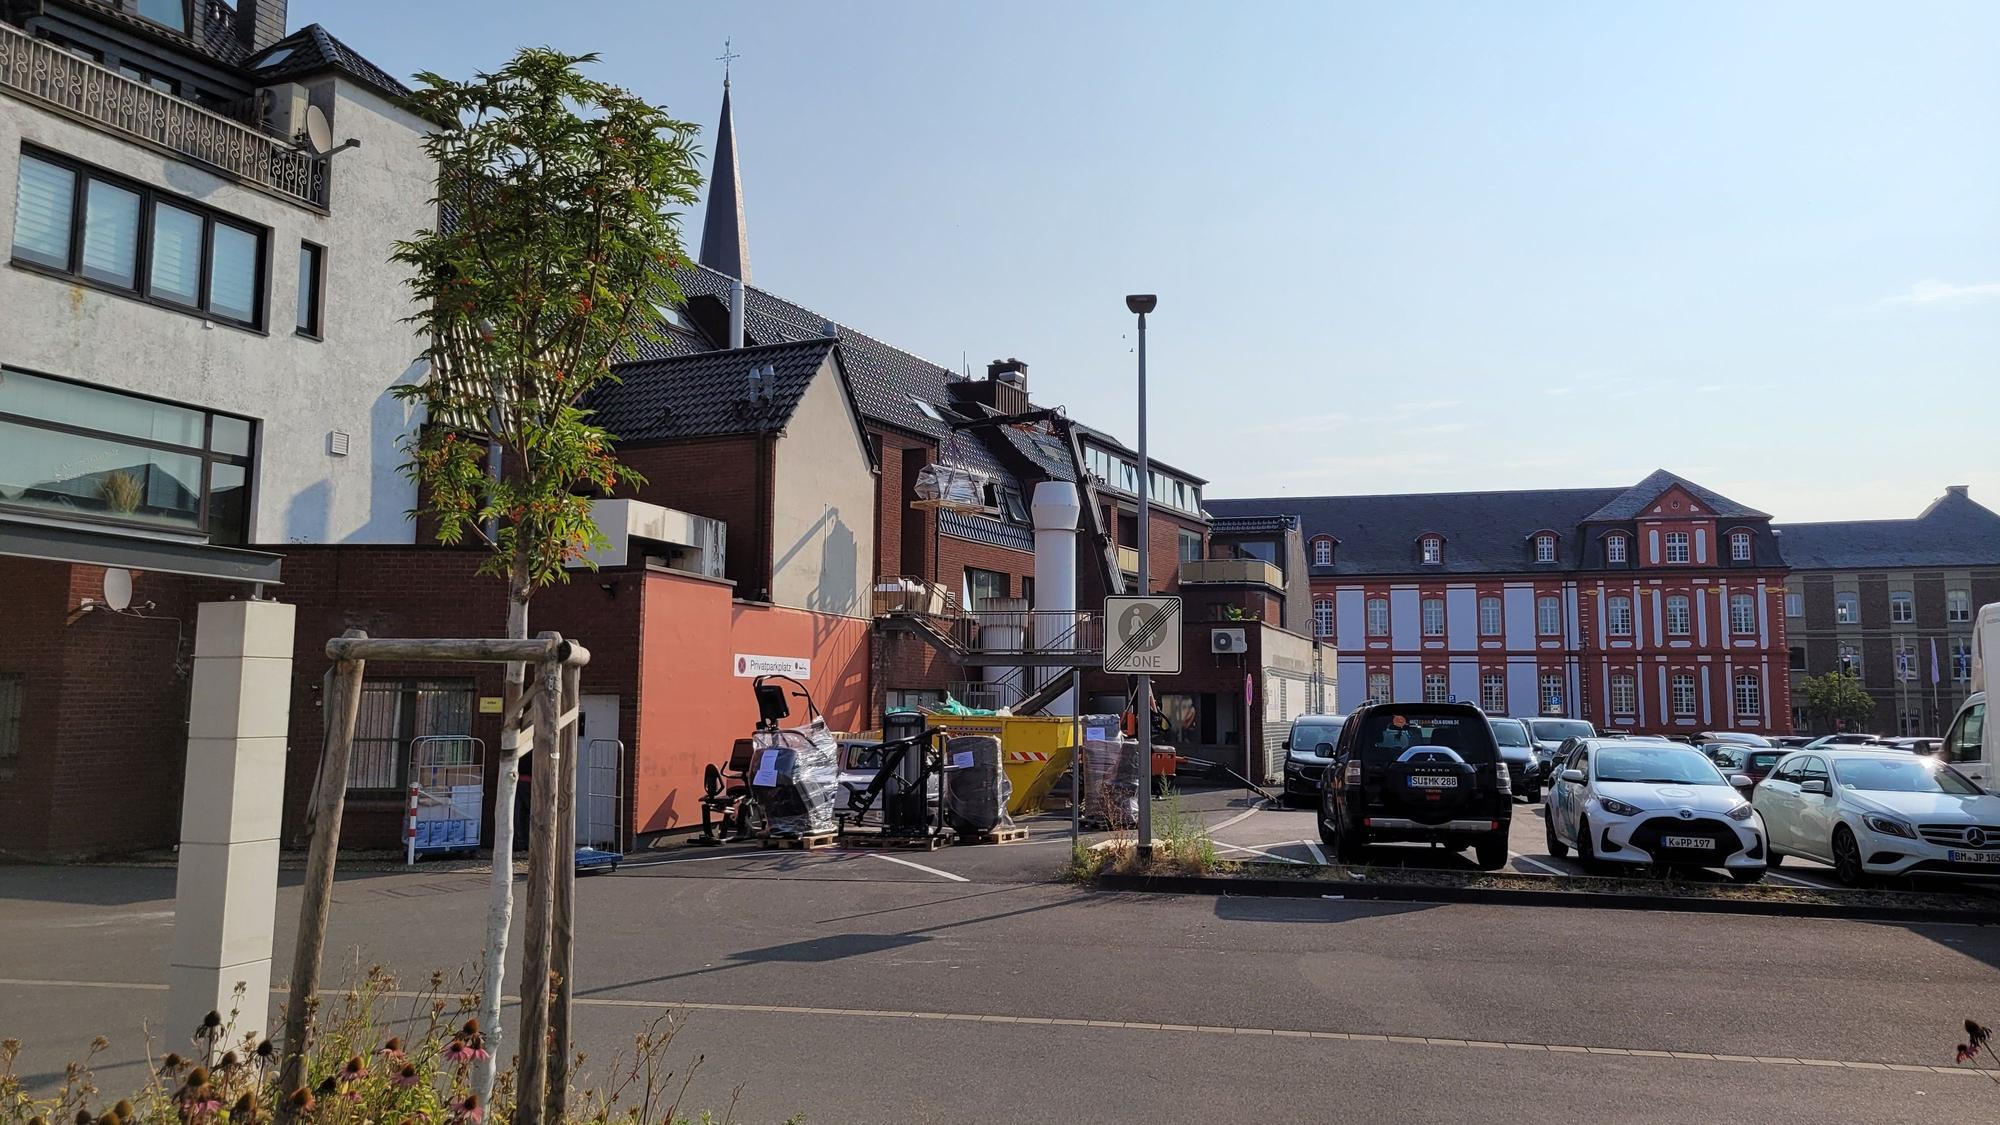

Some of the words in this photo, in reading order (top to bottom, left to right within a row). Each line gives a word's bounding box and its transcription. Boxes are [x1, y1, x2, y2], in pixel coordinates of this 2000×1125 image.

[750, 659, 792, 673] Privatparkplatz
[1124, 656, 1161, 667] ZONE
[1412, 776, 1424, 785] SU
[1441, 777, 1457, 786] 288
[1669, 837, 1675, 846] K
[1681, 838, 1693, 847] PP
[1694, 839, 1711, 848] 197
[1955, 851, 1967, 861] BM
[1973, 852, 1985, 862] JP
